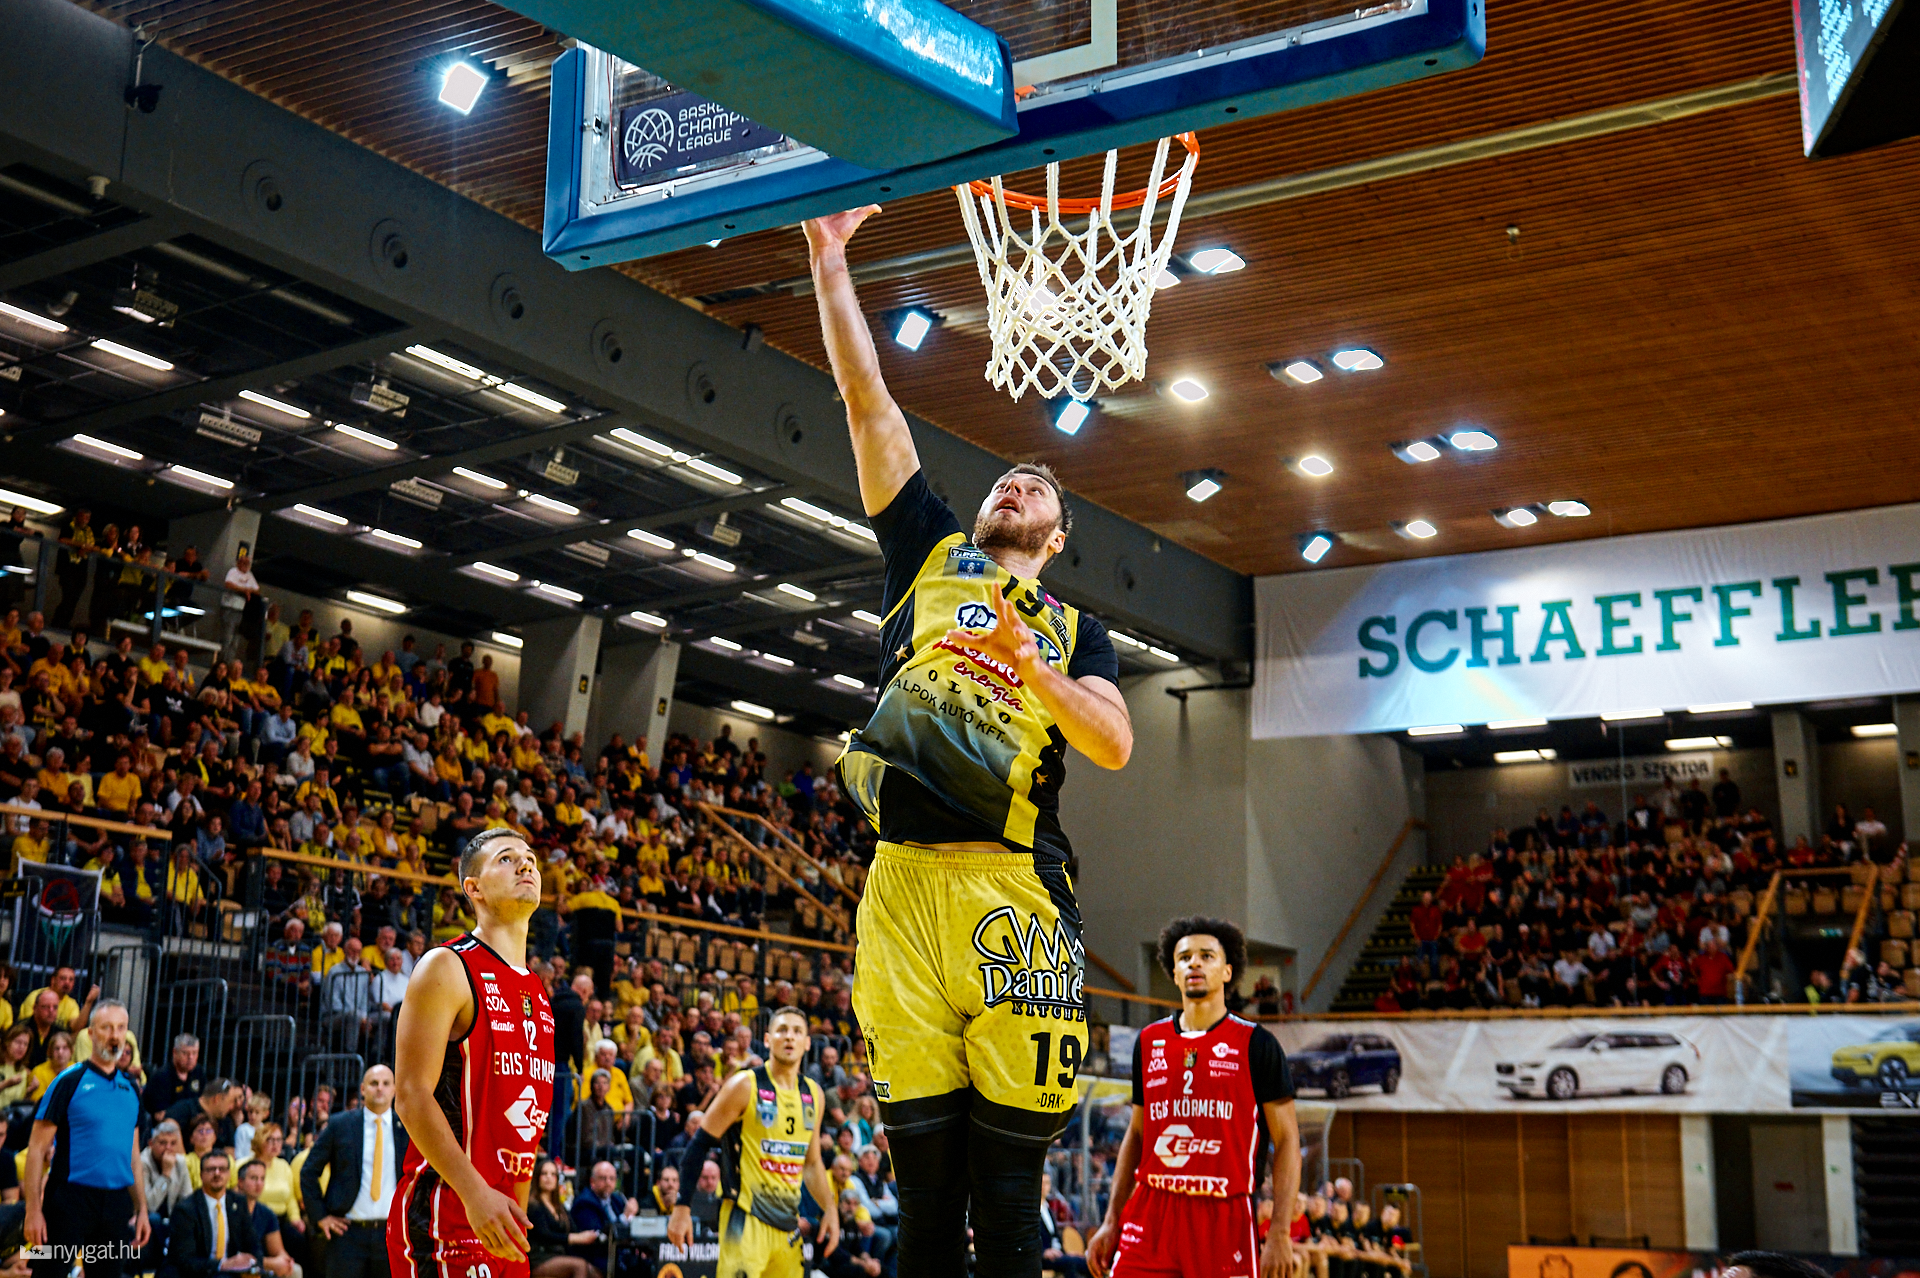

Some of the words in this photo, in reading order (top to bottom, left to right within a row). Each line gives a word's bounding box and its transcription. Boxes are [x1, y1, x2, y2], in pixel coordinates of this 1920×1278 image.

[677, 127, 732, 153] LEAGUE
[906, 663, 1013, 725] OLVO
[952, 660, 1024, 712] energia
[892, 678, 938, 707] ALPOK
[938, 700, 975, 724] AUTÓ
[975, 719, 1006, 744] KFT.
[522, 1019, 537, 1051] 12
[494, 1051, 523, 1075] EGIS
[1030, 1031, 1082, 1089] 19
[1182, 1070, 1194, 1095] 2
[1173, 1095, 1234, 1120] KÖRMEND
[785, 1116, 795, 1135] 3
[1174, 1138, 1222, 1155] EGIS
